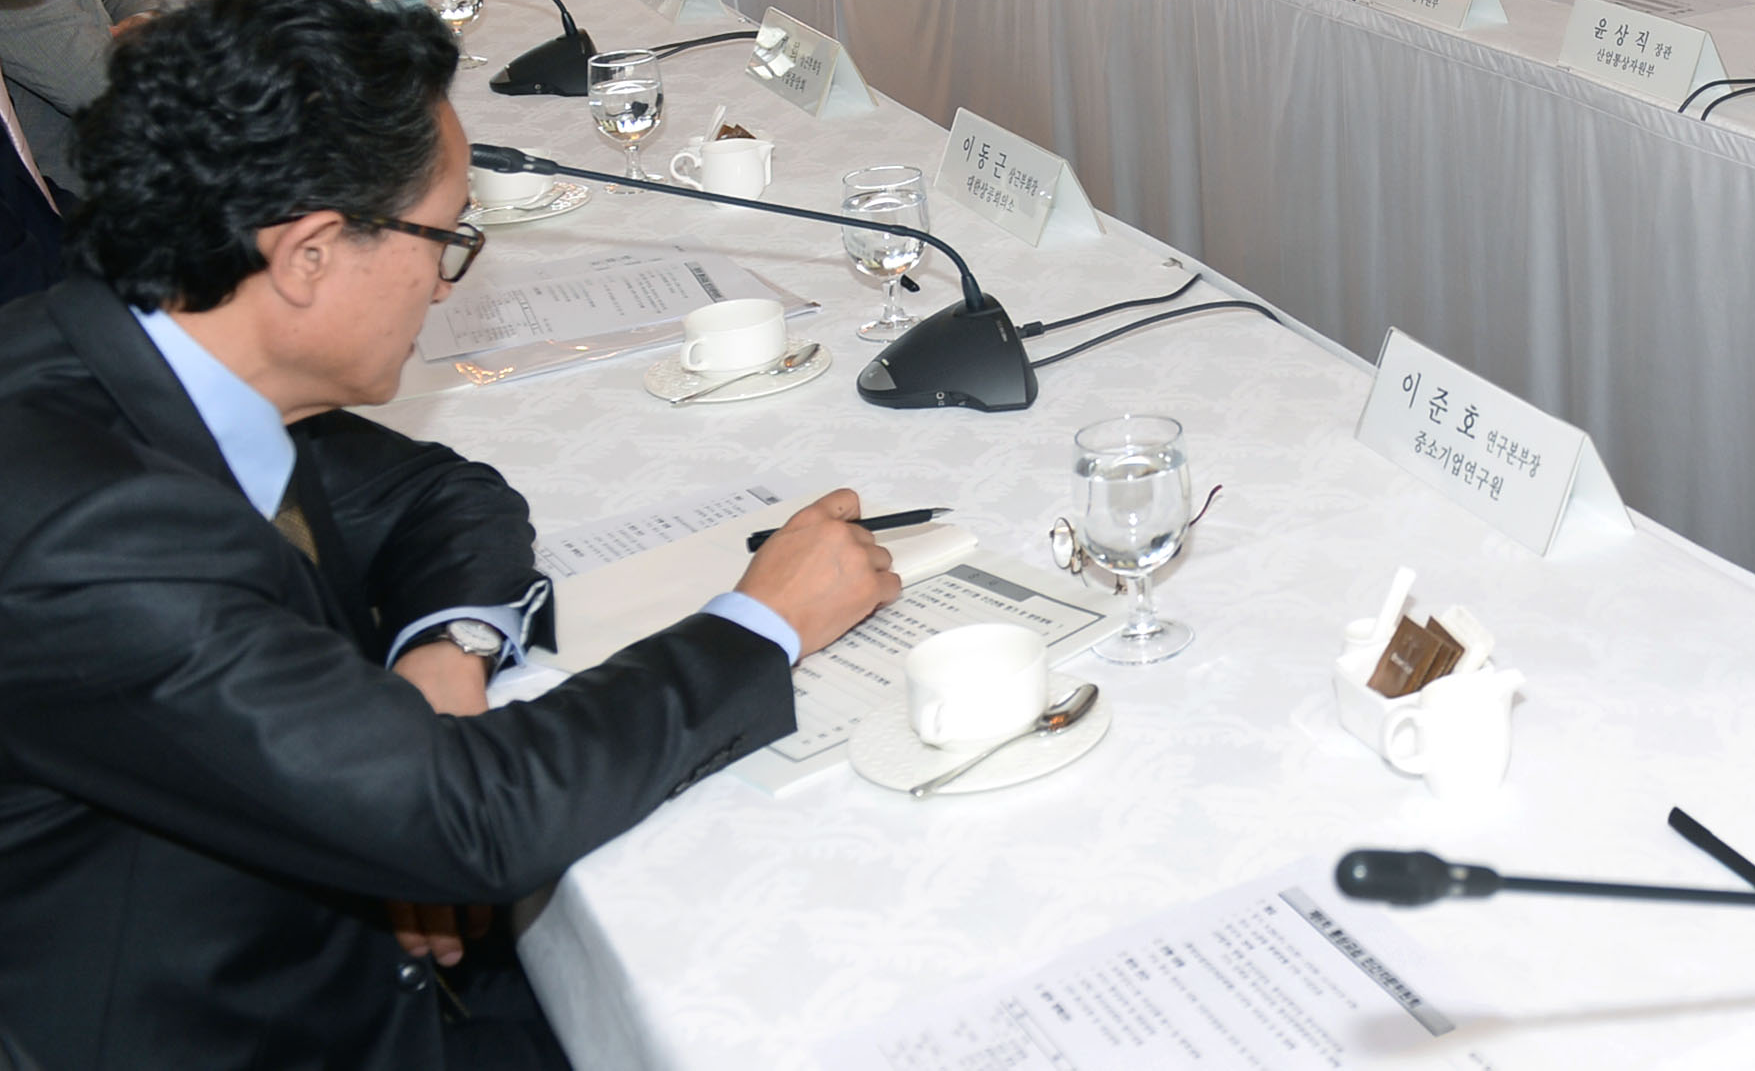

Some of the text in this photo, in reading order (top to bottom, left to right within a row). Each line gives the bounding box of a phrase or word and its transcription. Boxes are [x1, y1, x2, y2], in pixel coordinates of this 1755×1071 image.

[1596, 48, 1655, 78] 산업통상자원부
[1654, 43, 1672, 60] 장관
[1413, 430, 1504, 501] 중소기업연구원
[1486, 429, 1541, 479] 연구본부장
